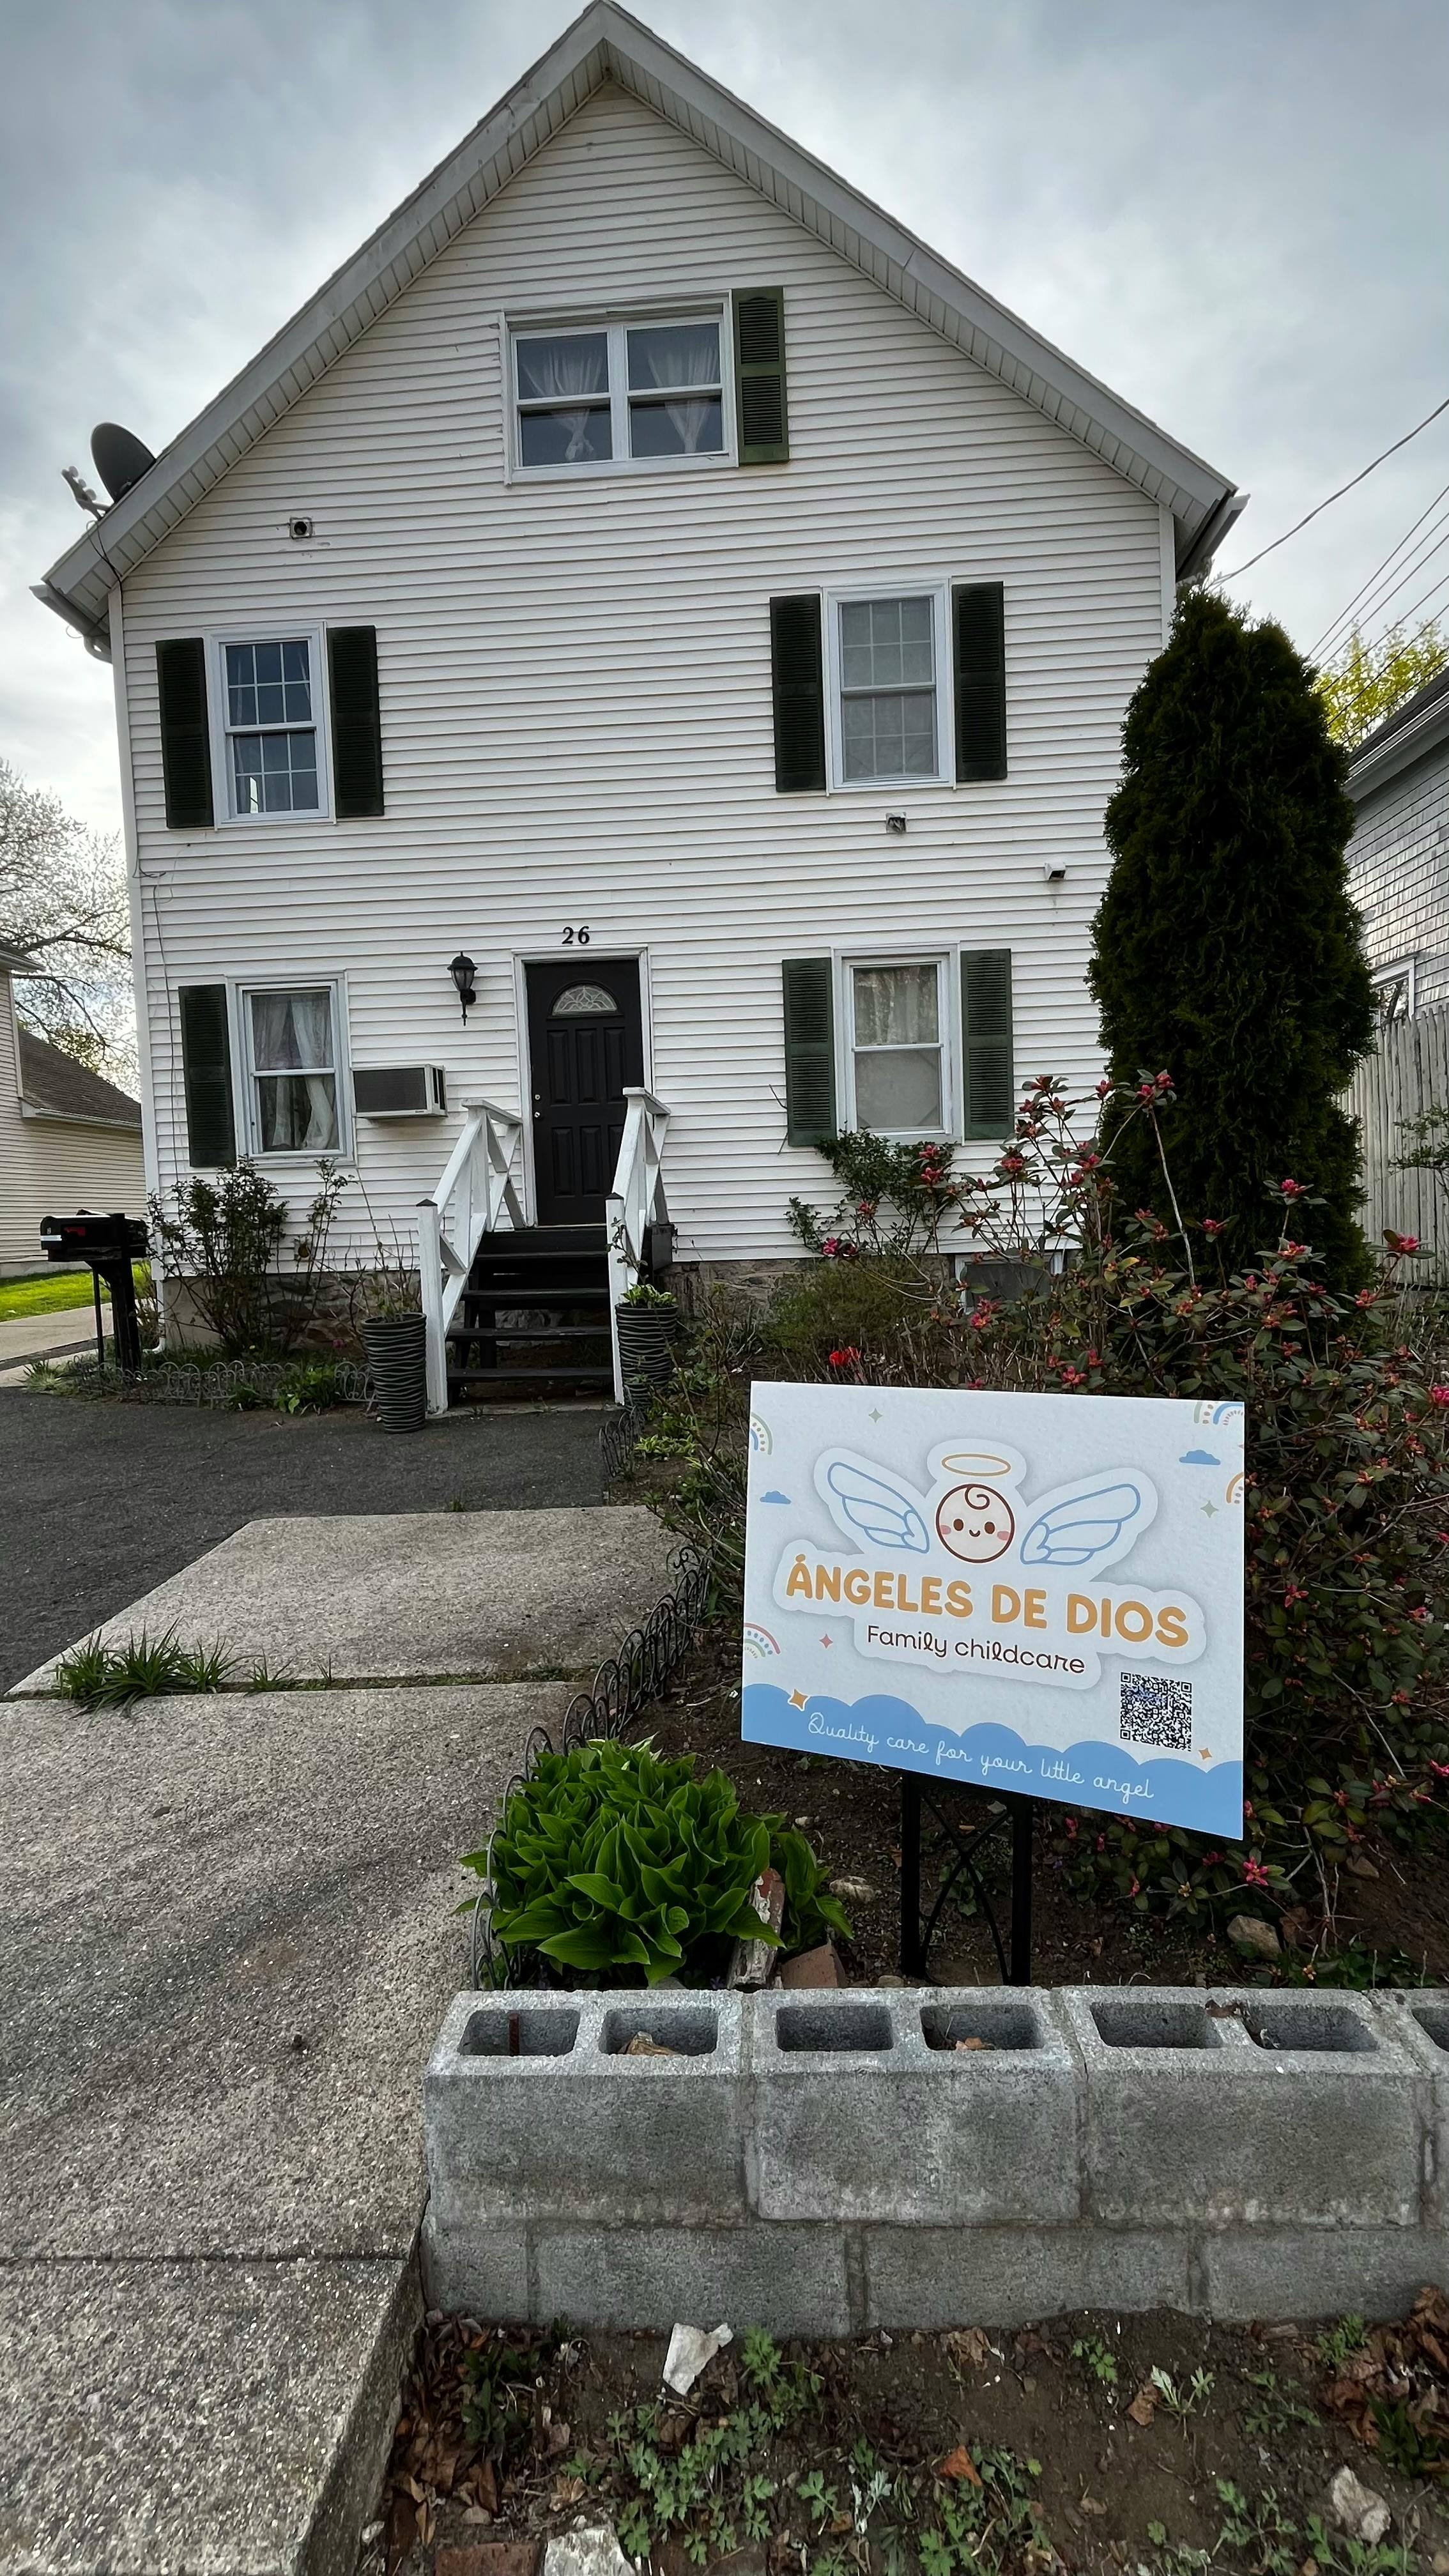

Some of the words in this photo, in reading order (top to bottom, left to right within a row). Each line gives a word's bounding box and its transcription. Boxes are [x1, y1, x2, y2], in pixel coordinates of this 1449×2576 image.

[562, 926, 590, 945] 26
[786, 1553, 974, 1618] ÁNGELES
[991, 1584, 1048, 1629] DE
[1066, 1593, 1189, 1648] DIOS
[868, 1625, 947, 1658] Family
[954, 1639, 1085, 1674] childcare
[808, 1712, 880, 1753] Quality
[886, 1735, 930, 1754] care
[935, 1740, 973, 1766] for
[981, 1754, 1033, 1776] your
[1041, 1758, 1085, 1784] little
[1092, 1776, 1154, 1805] angel
